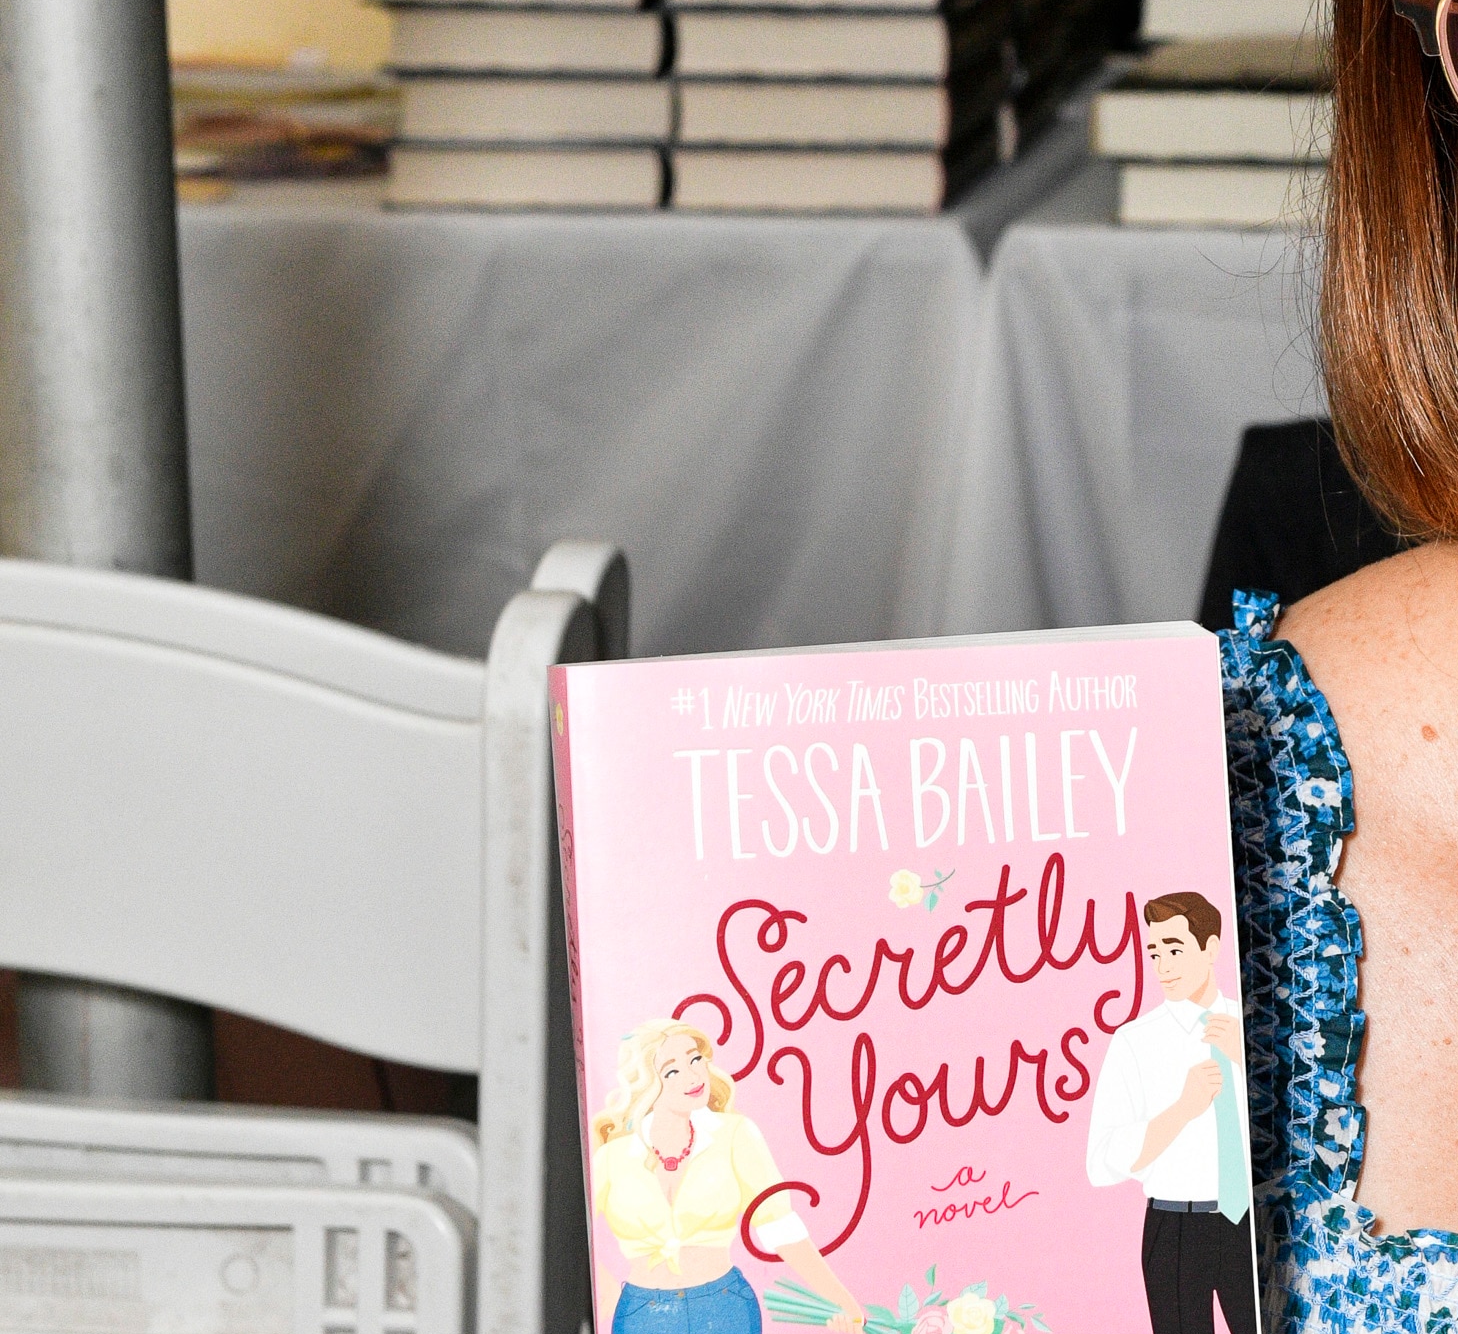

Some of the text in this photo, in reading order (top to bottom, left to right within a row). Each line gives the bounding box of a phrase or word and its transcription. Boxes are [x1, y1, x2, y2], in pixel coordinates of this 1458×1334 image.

[671, 671, 1138, 730] #1 NEW YORK TIMES BESTSELLING AUTHOR
[672, 726, 1138, 861] TESSA BAILEY
[671, 853, 1144, 1082] Secretly
[740, 1028, 1091, 1262] Yours
[931, 1166, 987, 1192] a
[913, 1182, 1040, 1229] novel
